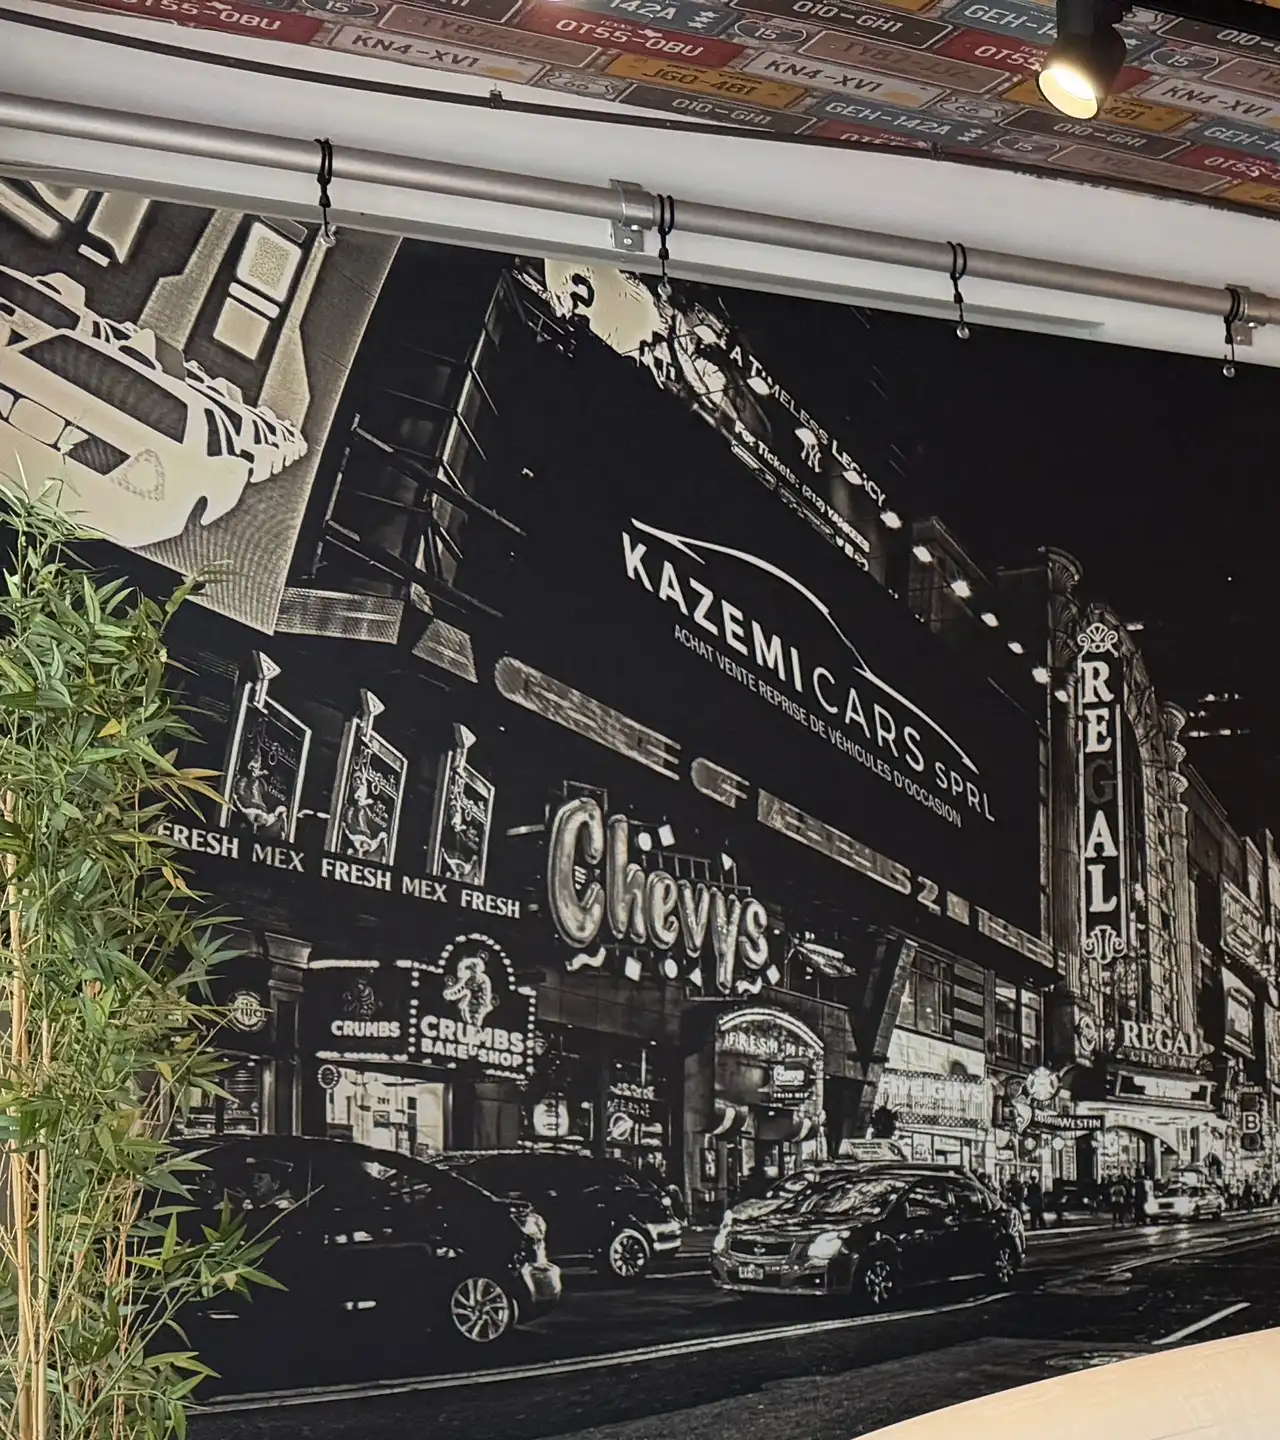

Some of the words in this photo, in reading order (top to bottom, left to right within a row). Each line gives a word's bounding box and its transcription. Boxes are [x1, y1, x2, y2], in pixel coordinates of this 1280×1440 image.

[753, 26, 779, 42] 15
[1165, 53, 1195, 68] 15
[824, 101, 954, 137] GEH-142A
[621, 530, 804, 693] KAZEMI
[811, 665, 926, 774] CARS
[934, 760, 996, 823] SPRL
[674, 623, 715, 662] ACHAT
[716, 651, 758, 693] VENTE
[758, 681, 810, 726] REPRISE
[809, 713, 828, 739] DE
[827, 725, 893, 783] VÉHICULES
[893, 768, 963, 829] D'OCCASION
[1080, 659, 1120, 915] REGAL
[251, 842, 306, 874] MEX
[321, 857, 393, 892] FRESH
[401, 875, 449, 904] MEX
[460, 889, 522, 919] FRESH
[547, 797, 769, 996] Chevys
[330, 1020, 401, 1038] CRUMBS
[420, 1014, 526, 1054] CRUMBS
[1120, 1018, 1201, 1057] REGAL
[420, 1037, 470, 1061] BAKE
[477, 1049, 524, 1068] SHOP
[1058, 1116, 1102, 1130] WESTIN
